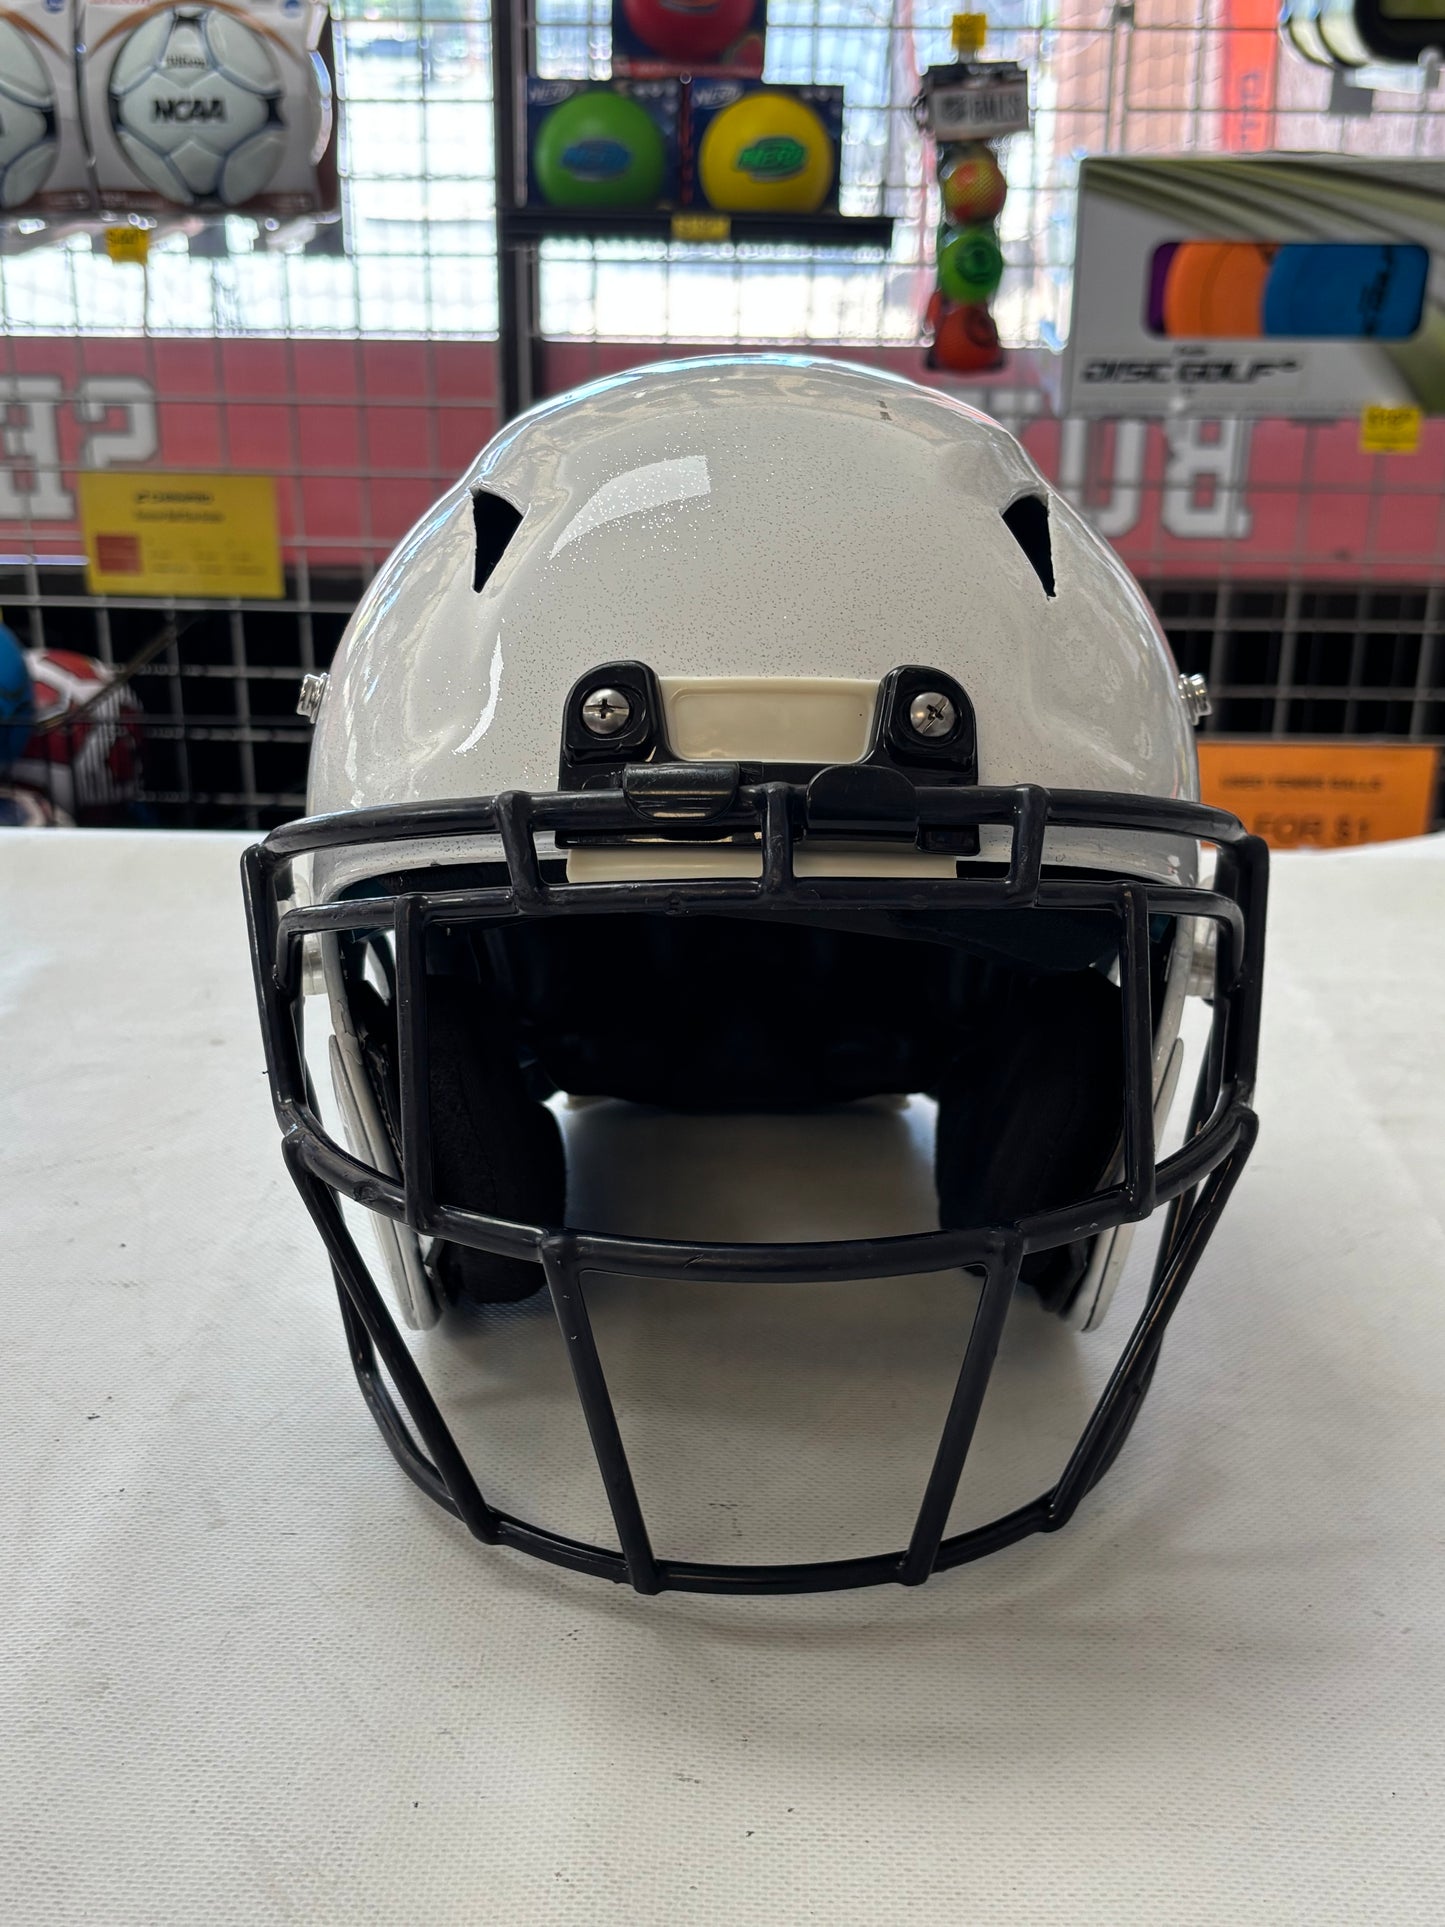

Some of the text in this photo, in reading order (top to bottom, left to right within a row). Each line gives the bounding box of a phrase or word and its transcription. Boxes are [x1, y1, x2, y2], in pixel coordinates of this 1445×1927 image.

[153, 98, 225, 123] NCAA
[1083, 359, 1172, 384] DISC
[1176, 359, 1277, 384] GOLF
[1253, 812, 1323, 844] FOR
